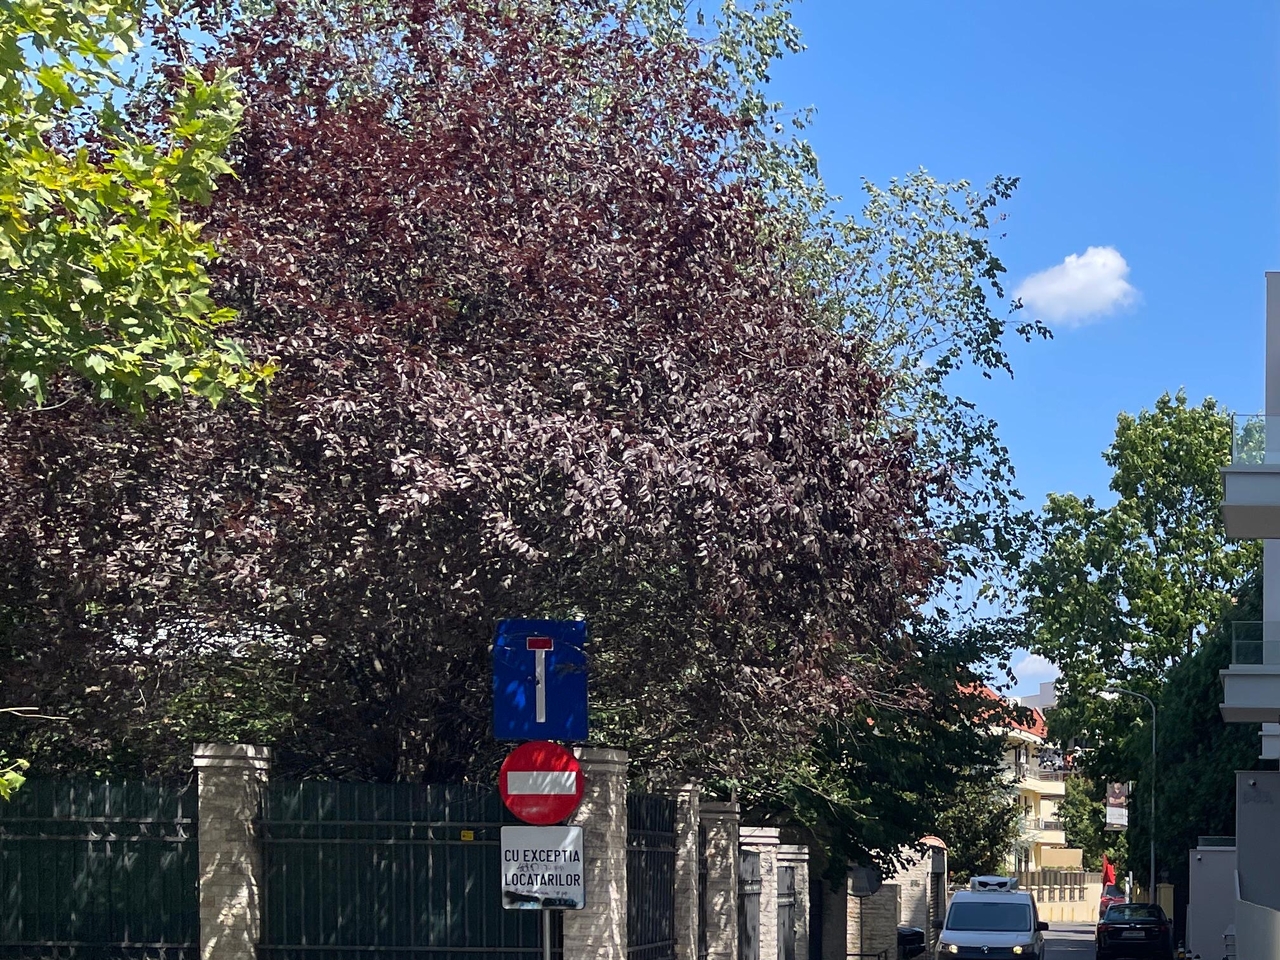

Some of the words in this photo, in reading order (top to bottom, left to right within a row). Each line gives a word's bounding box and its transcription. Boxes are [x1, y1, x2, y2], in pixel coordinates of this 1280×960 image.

[504, 849, 519, 863] CU
[523, 849, 581, 863] EXCEPTIA
[504, 873, 581, 887] LOCATARILOR
